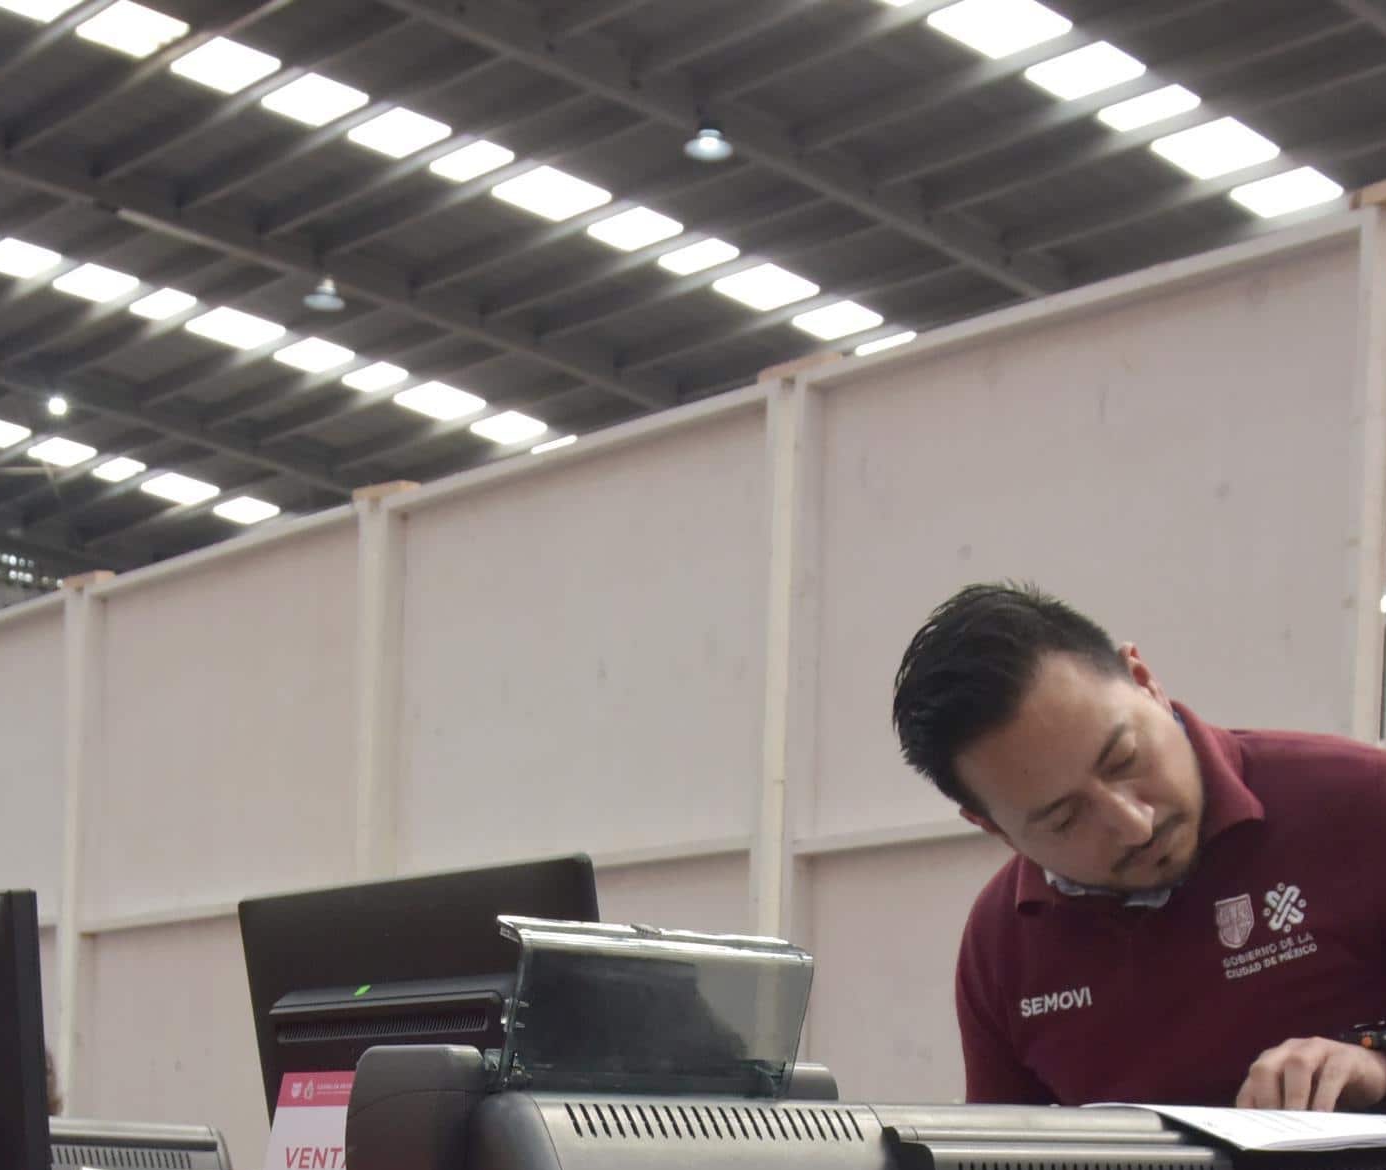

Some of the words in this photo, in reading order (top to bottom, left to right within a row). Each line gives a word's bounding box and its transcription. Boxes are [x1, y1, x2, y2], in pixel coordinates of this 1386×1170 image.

[1222, 942, 1277, 968] GOBIERNO
[1280, 936, 1294, 950] DE
[1297, 931, 1314, 944] LA
[1225, 961, 1262, 979] CIUDAD
[1263, 955, 1278, 968] DE
[1278, 942, 1317, 962] MÉXICO
[1020, 985, 1092, 1018] SEMOVI
